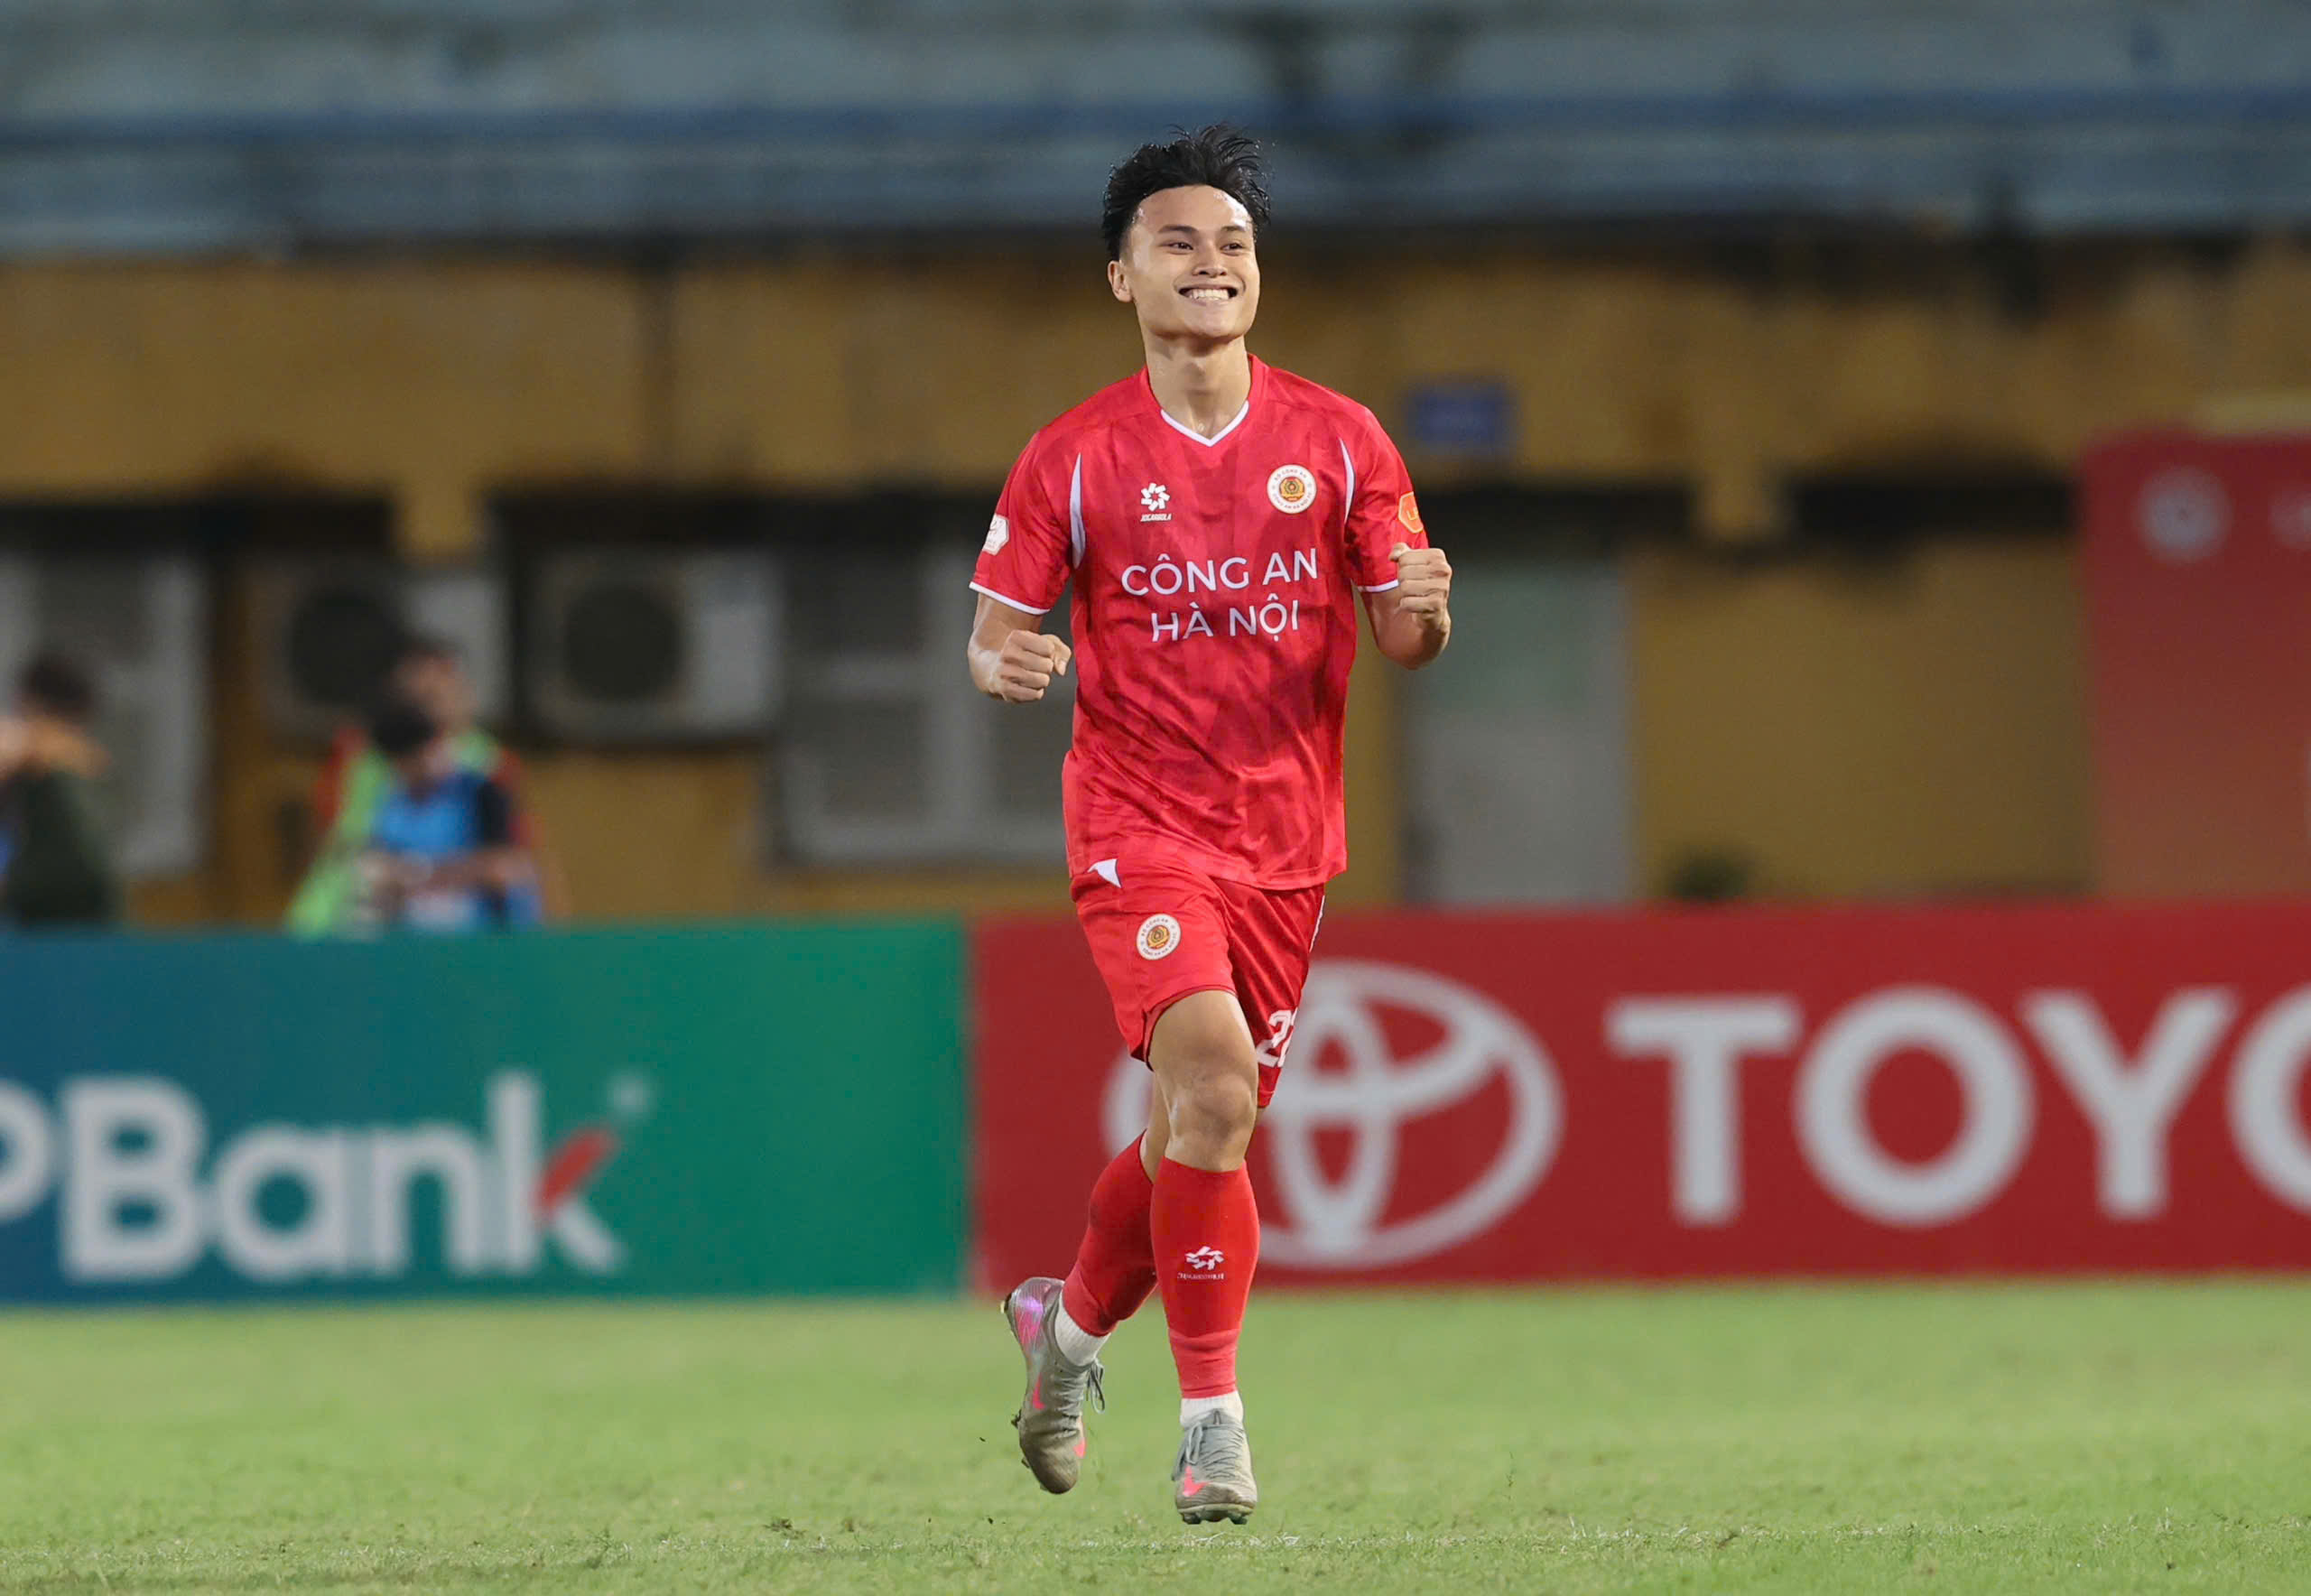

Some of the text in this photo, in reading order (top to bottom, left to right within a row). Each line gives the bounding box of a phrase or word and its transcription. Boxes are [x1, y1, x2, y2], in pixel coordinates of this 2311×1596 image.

[1121, 548, 1318, 596] CÔNG AN
[1151, 592, 1299, 642] HÀ NỘI
[1256, 1007, 1298, 1068] 2
